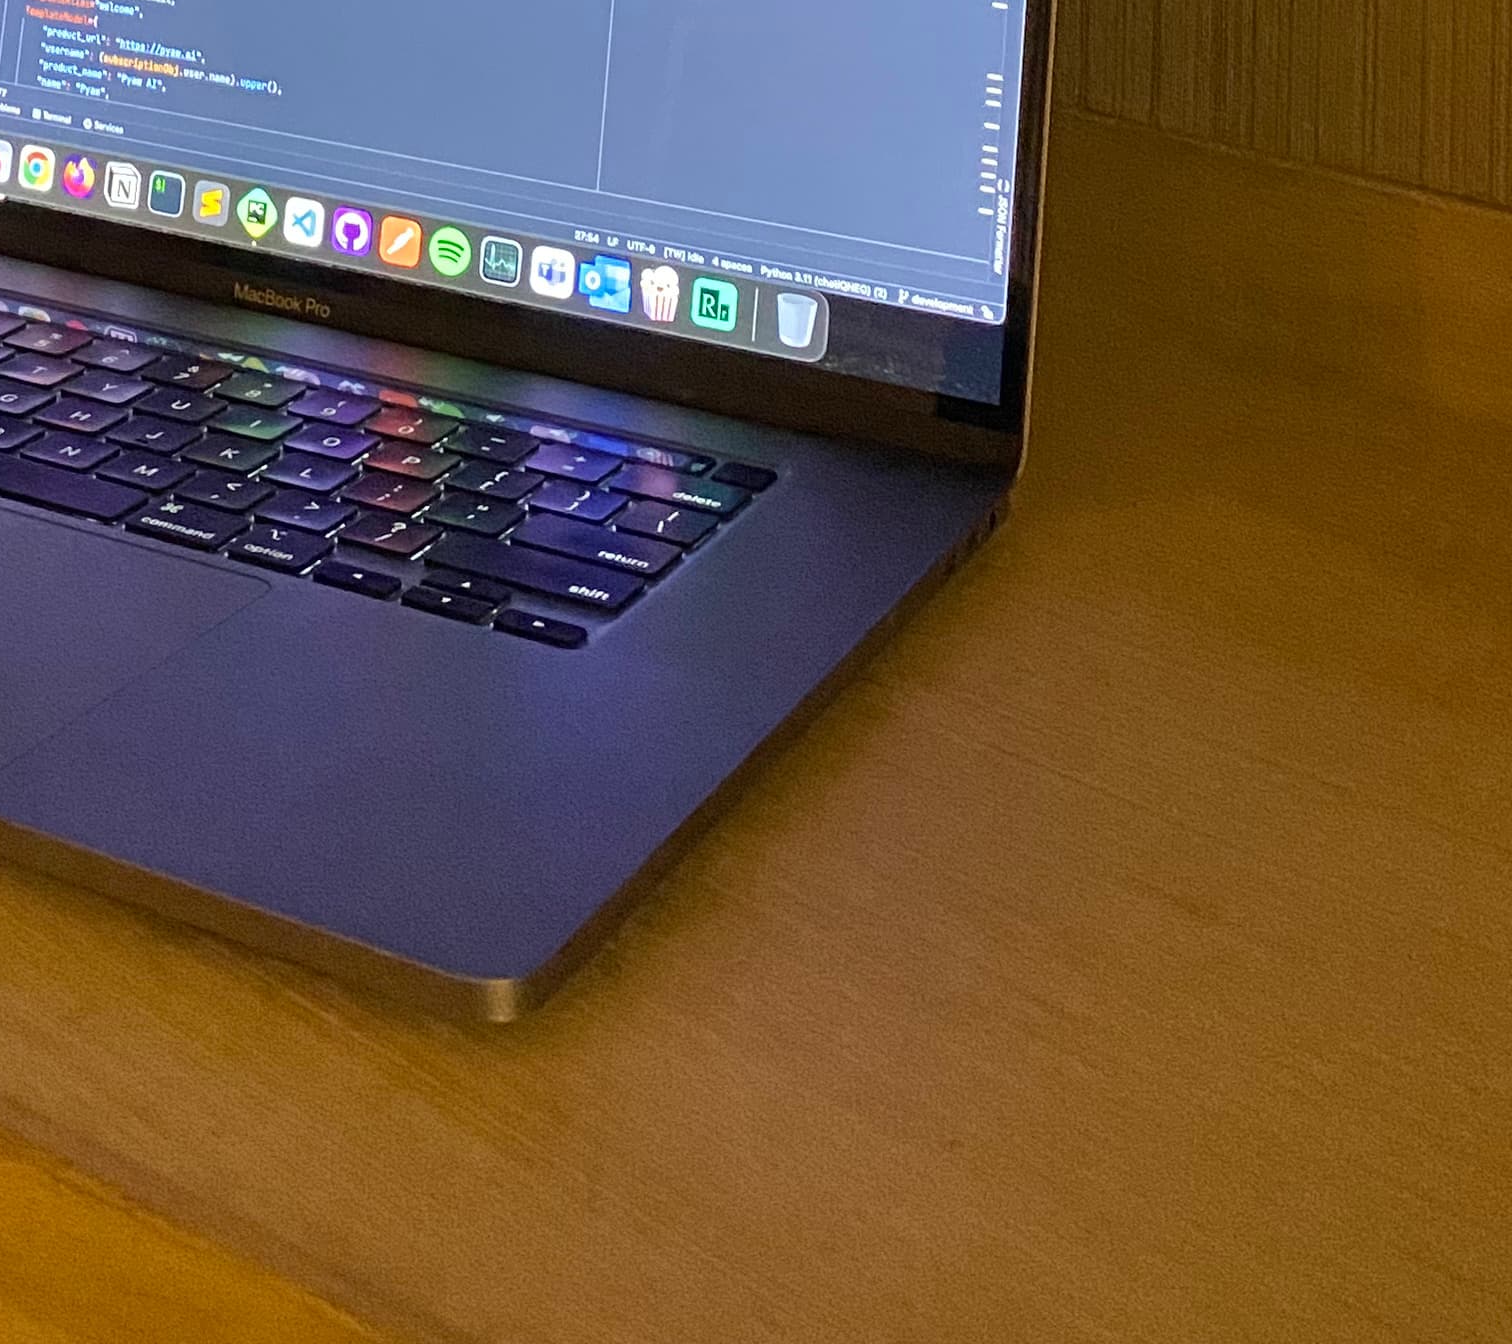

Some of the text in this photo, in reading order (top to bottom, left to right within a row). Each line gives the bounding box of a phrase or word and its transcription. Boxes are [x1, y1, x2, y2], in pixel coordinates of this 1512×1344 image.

[720, 258, 753, 274] spaces
[760, 264, 793, 282] Python
[233, 282, 331, 319] MacBook Pro
[671, 490, 722, 509] delete
[140, 514, 216, 541] command
[242, 542, 294, 562] option
[598, 548, 649, 570] return
[568, 583, 610, 601] shift
